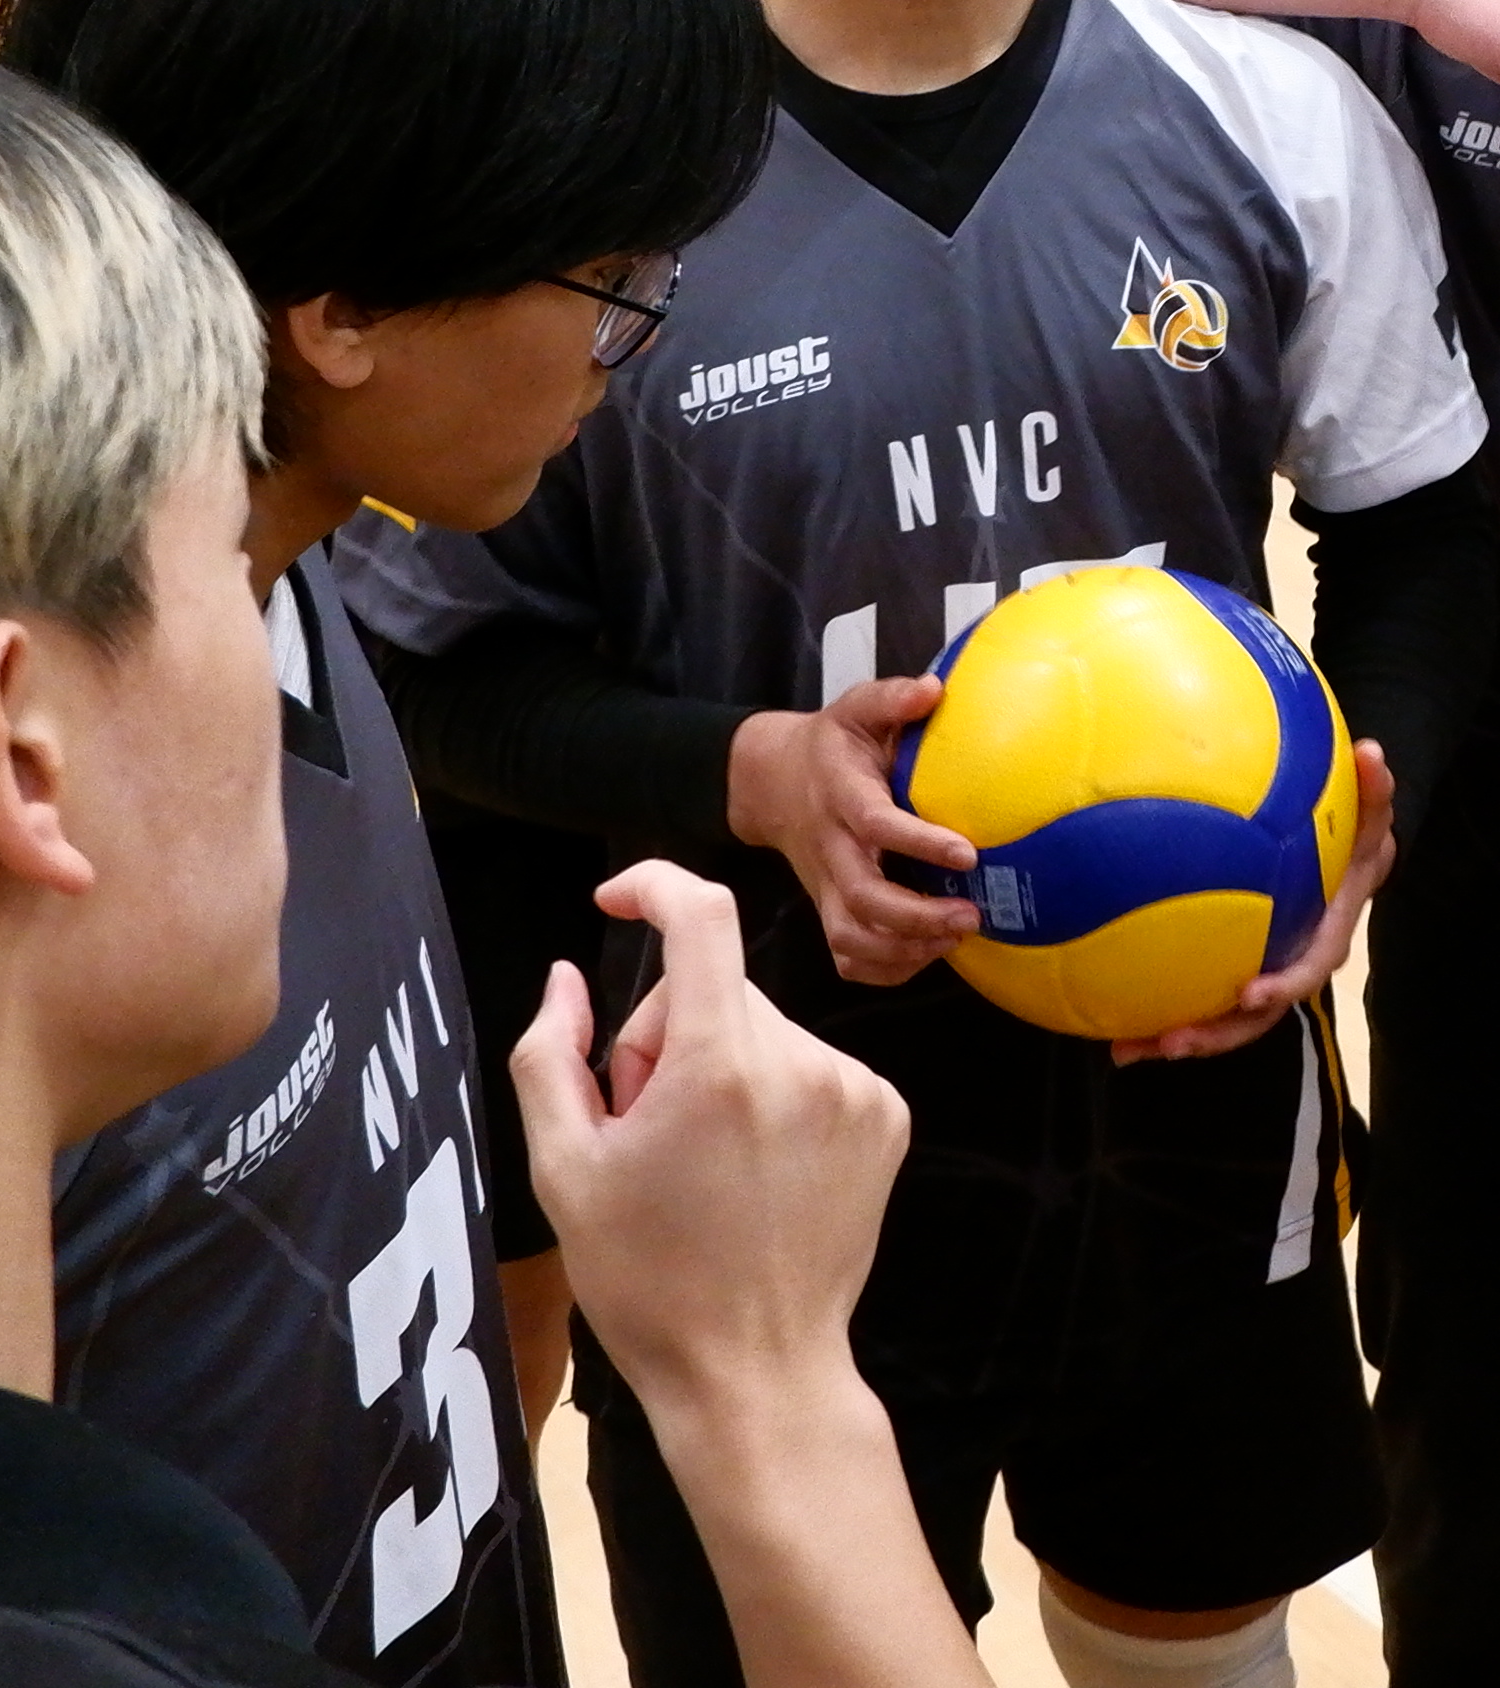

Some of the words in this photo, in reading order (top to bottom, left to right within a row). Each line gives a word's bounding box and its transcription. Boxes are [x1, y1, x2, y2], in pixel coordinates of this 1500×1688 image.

[678, 335, 831, 411] joust
[682, 372, 832, 426] VOLLEY
[887, 410, 1062, 532] NVC
[348, 1070, 500, 1659] 3
